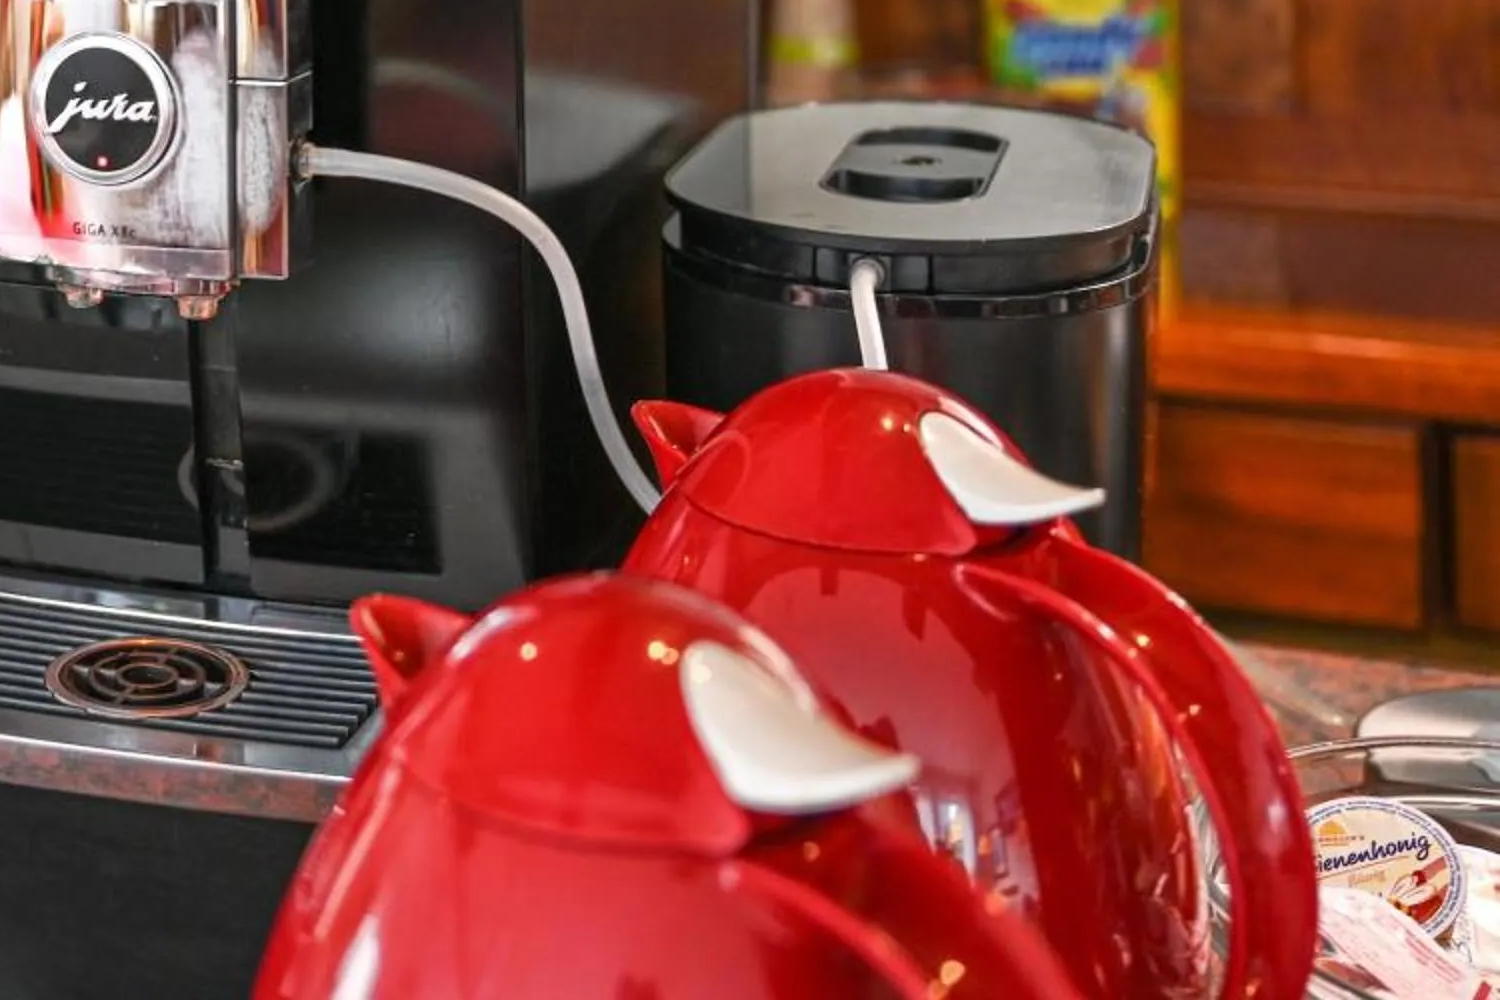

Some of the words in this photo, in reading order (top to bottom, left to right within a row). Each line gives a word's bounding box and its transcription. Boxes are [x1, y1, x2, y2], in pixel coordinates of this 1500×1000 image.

[47, 81, 156, 137] jura
[72, 221, 106, 237] GIGA
[1314, 832, 1432, 873] ienenhonig
